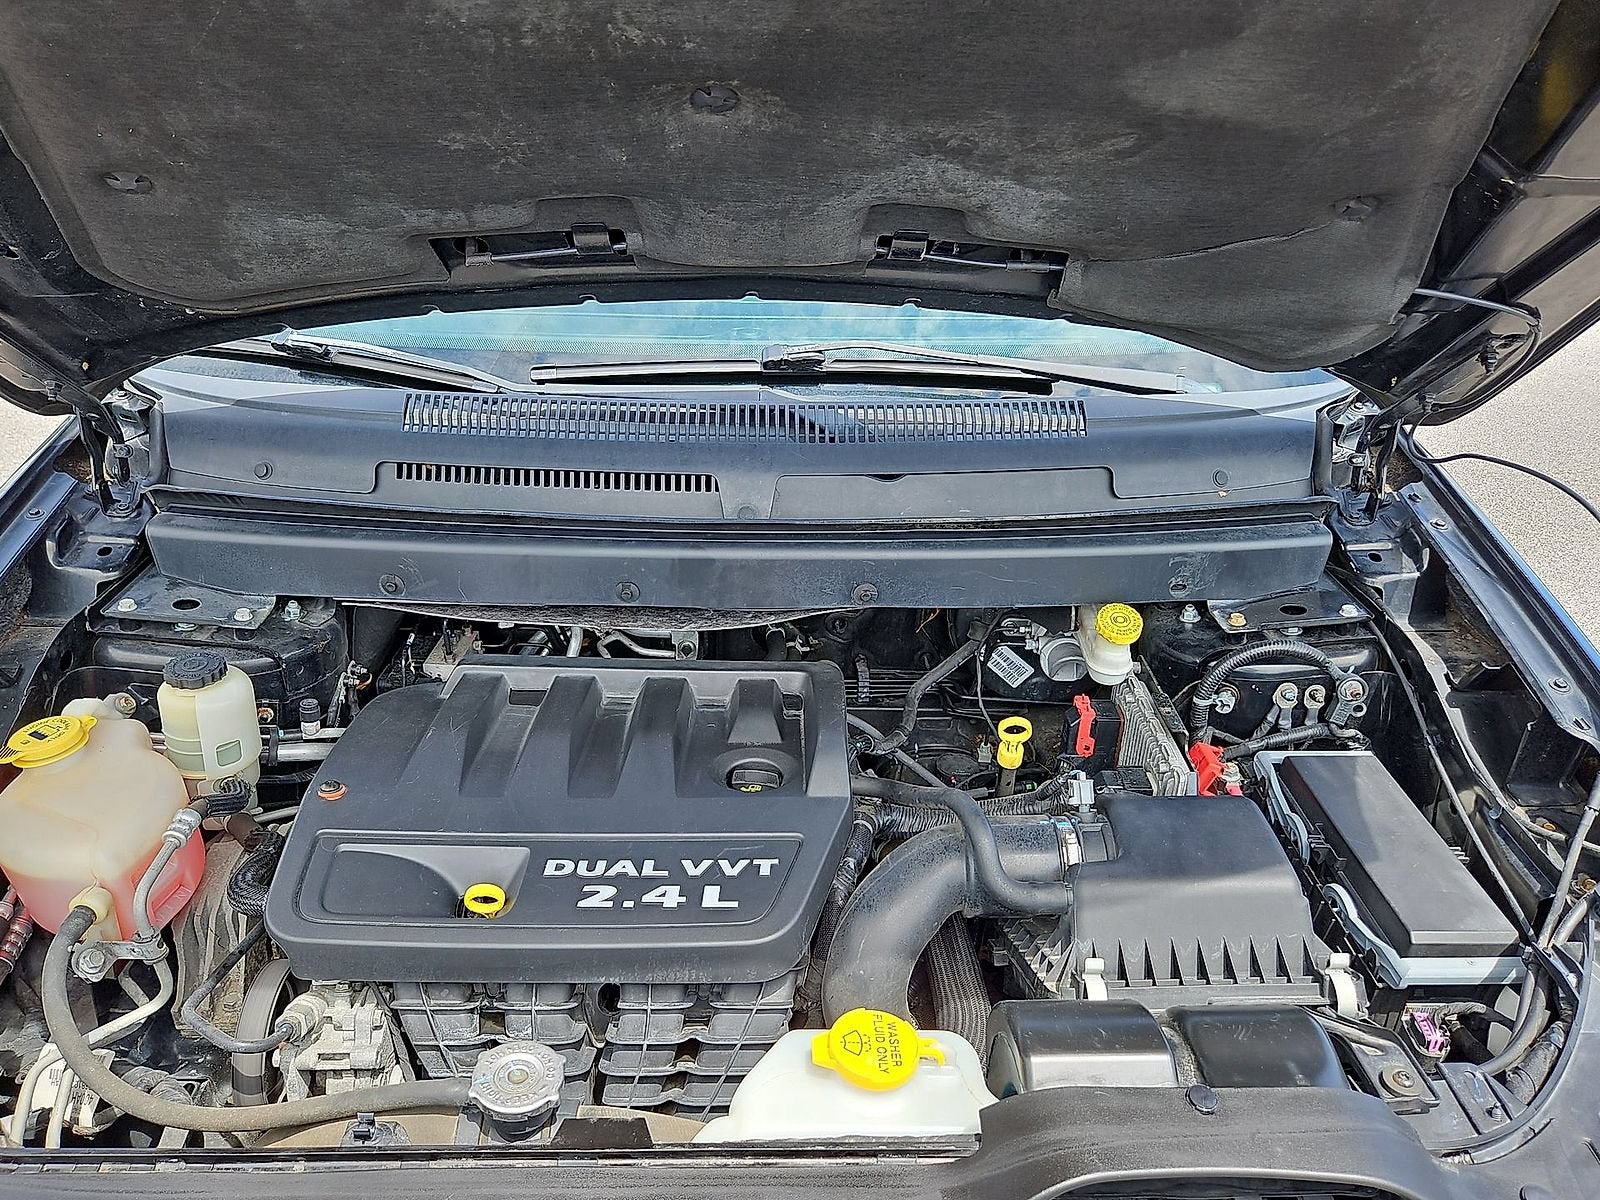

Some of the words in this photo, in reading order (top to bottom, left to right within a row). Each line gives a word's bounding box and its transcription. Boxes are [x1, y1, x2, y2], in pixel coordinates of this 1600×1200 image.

[543, 859, 670, 878] DUAL
[680, 858, 780, 878] VVT
[576, 884, 687, 909] 2.4
[700, 884, 740, 909] L
[872, 1014, 886, 1044] FLUID
[887, 1021, 903, 1067] WASHER
[876, 1046, 890, 1074] ONLY
